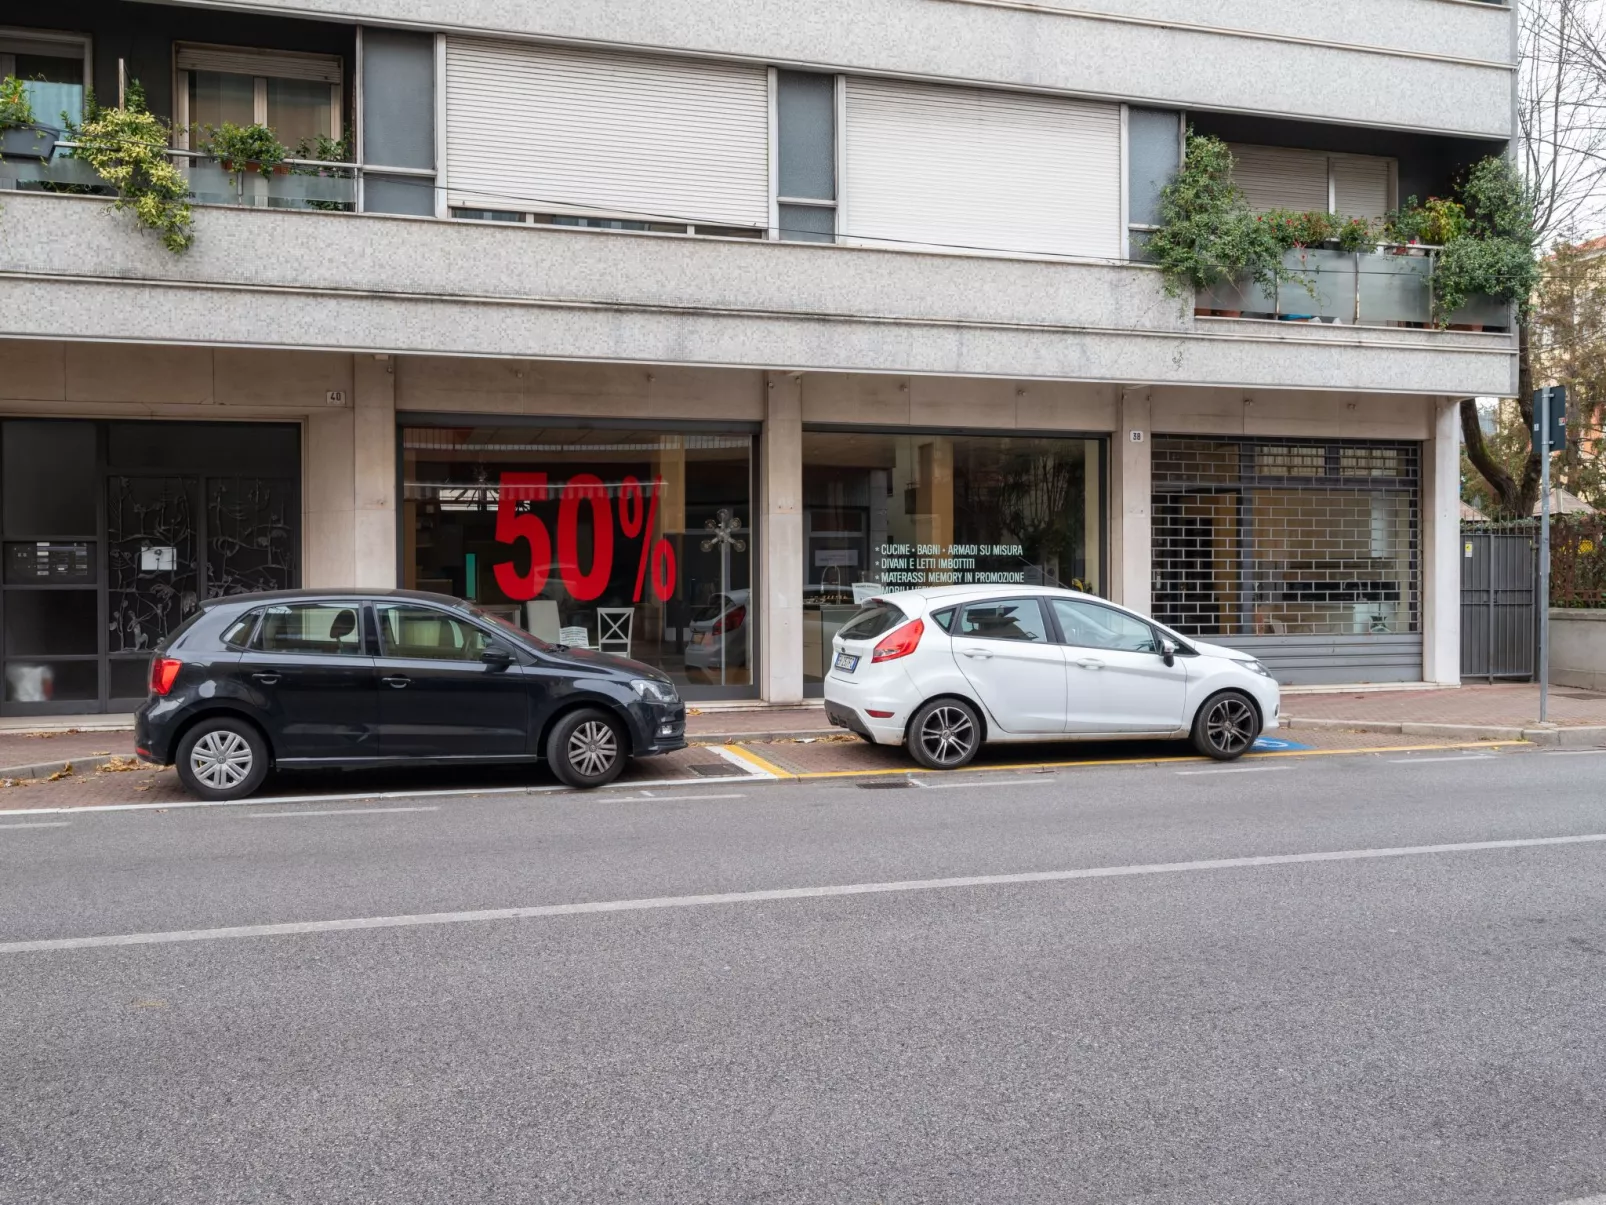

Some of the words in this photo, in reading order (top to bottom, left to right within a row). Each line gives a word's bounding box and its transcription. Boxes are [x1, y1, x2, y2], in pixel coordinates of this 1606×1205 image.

[330, 392, 341, 401] 40
[492, 472, 677, 603] 50%
[881, 544, 910, 555] CUCINE
[917, 544, 941, 555] BAGNI
[947, 544, 978, 556] ARMADI
[979, 544, 991, 556] SU
[992, 544, 1024, 556] MISURA
[881, 558, 907, 569] DIVANI
[909, 558, 915, 569] E
[916, 558, 936, 569] LETTI
[938, 558, 975, 569] IMBOTTITI
[881, 572, 926, 583] MATERASSI
[928, 572, 963, 583] MEMORY
[964, 572, 973, 583] IN
[975, 572, 1025, 583] PROMOZIONE
